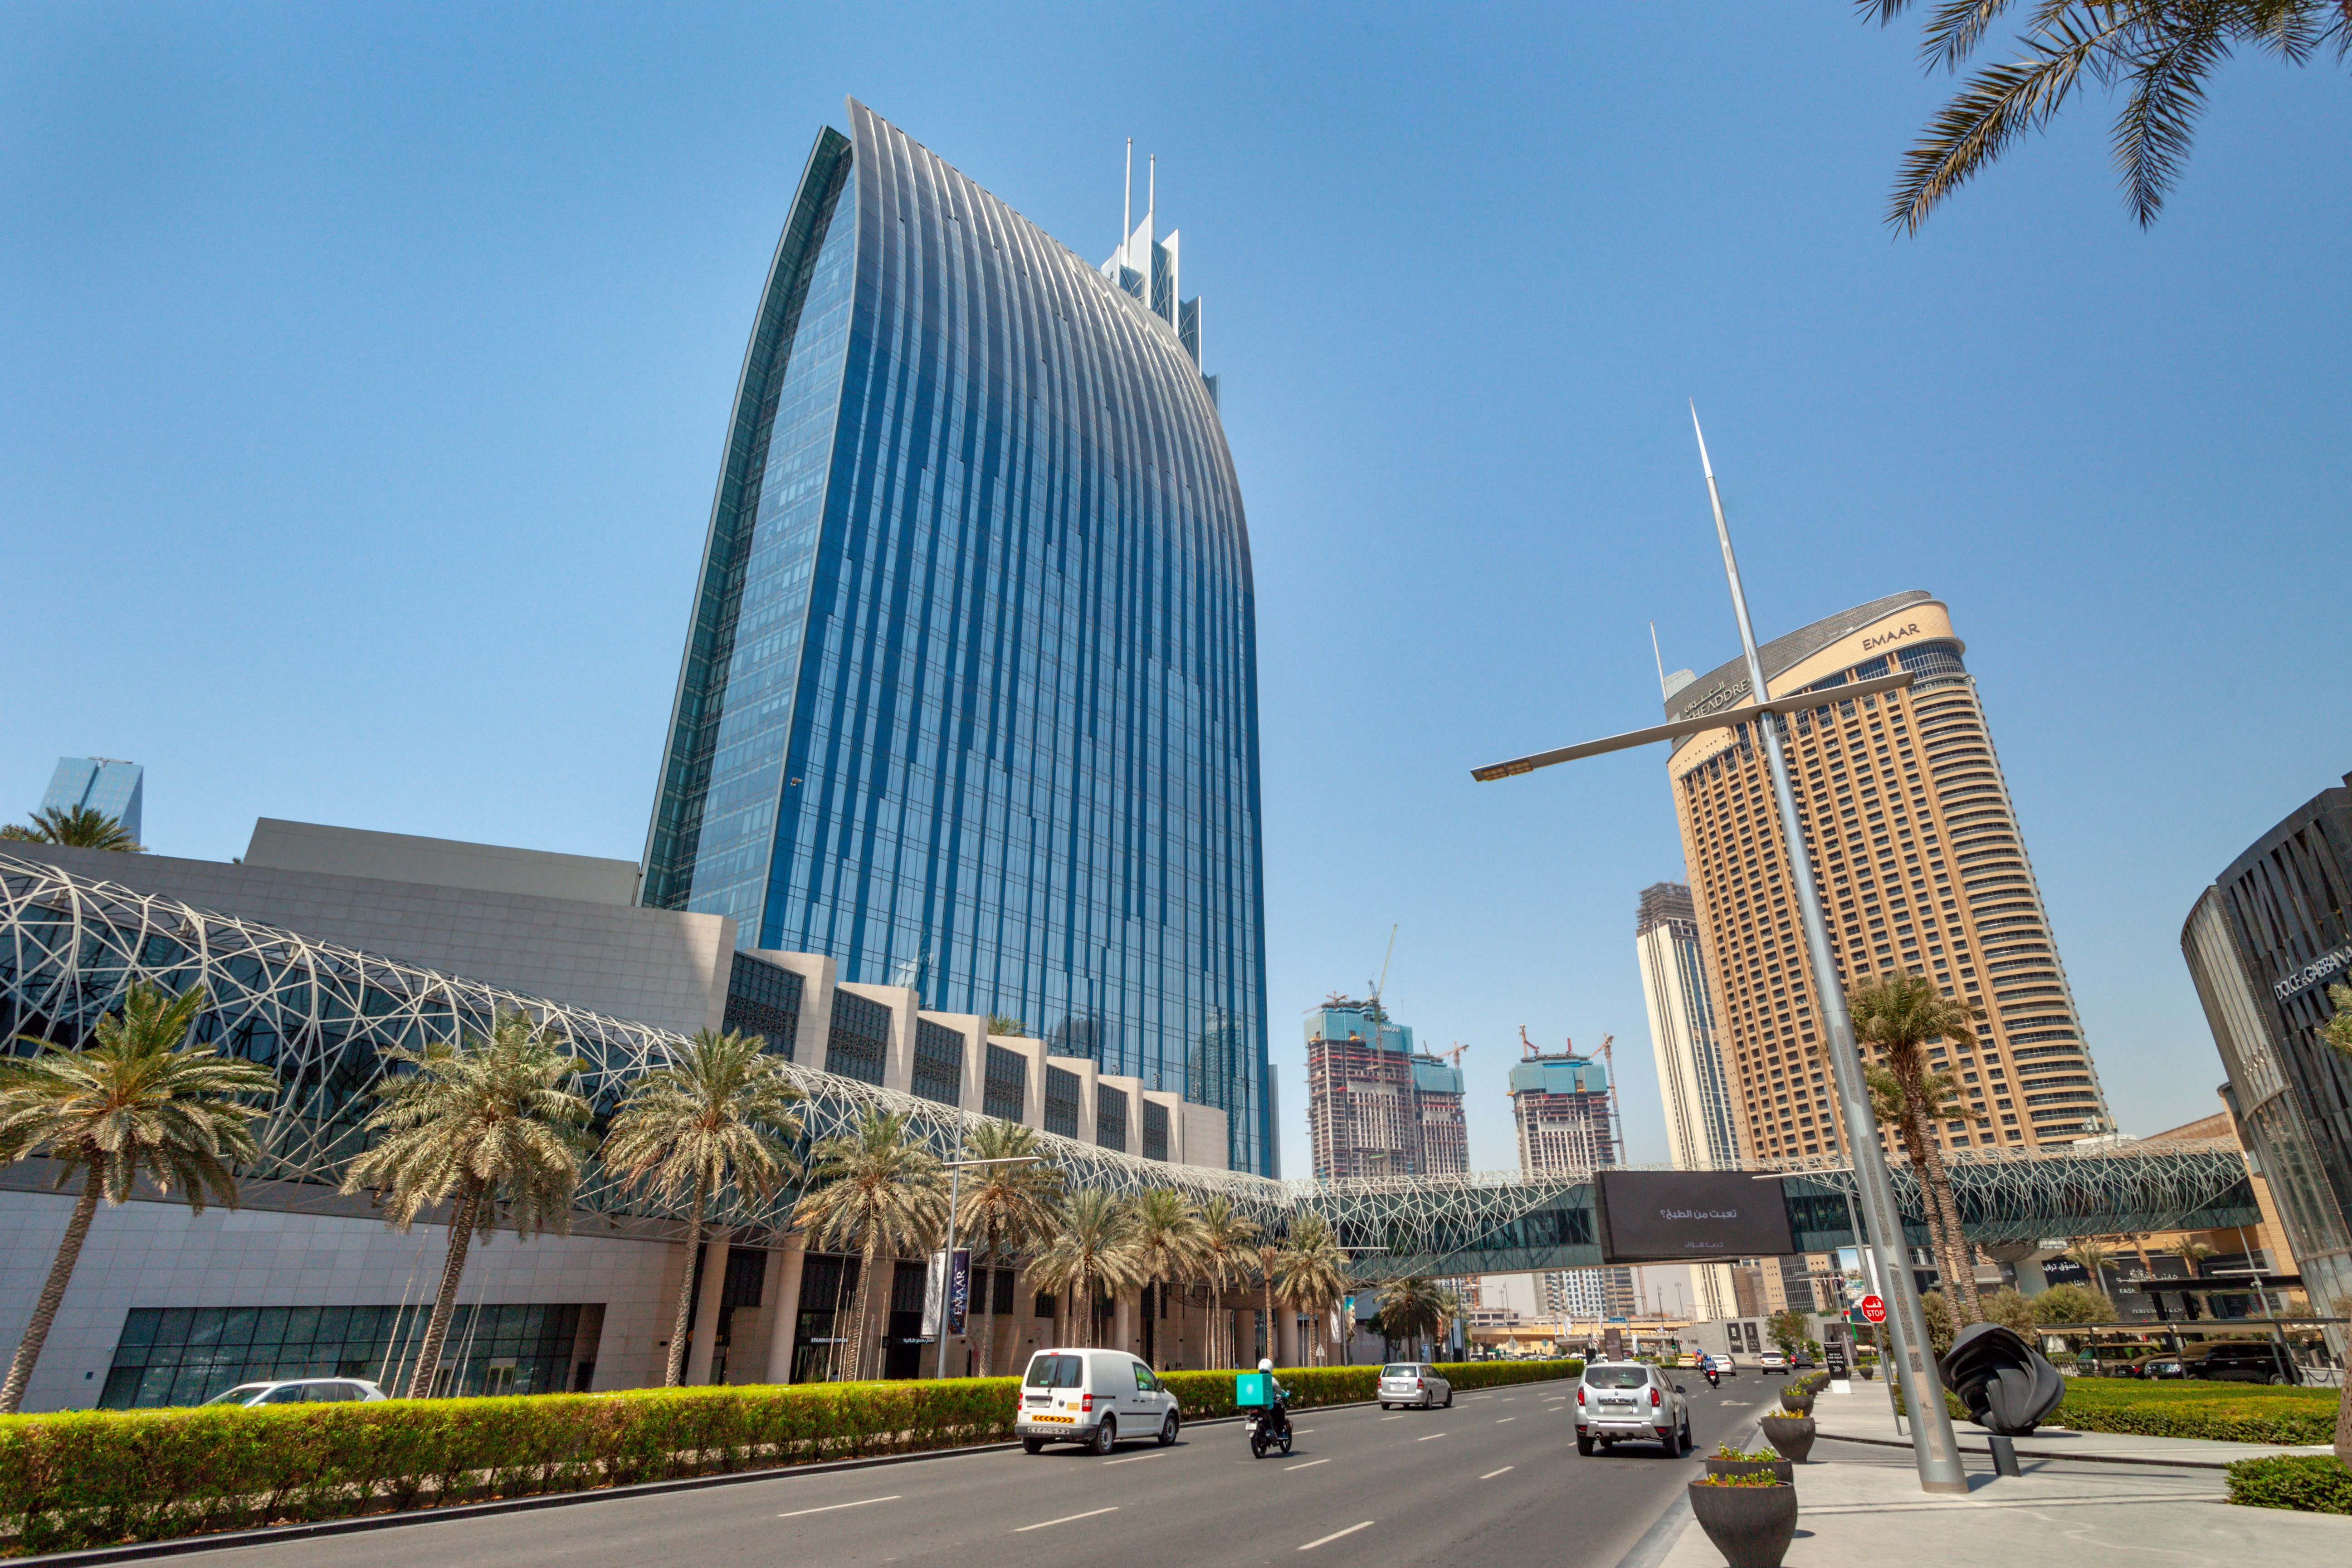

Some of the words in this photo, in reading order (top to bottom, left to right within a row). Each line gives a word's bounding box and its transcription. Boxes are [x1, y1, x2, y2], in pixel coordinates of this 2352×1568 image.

[1862, 623, 1921, 651] EMAAR
[1694, 1210, 1708, 1220] من
[1709, 1209, 1737, 1219] تعبت
[954, 1270, 966, 1315] EMAAR
[1865, 1299, 1882, 1308] قف
